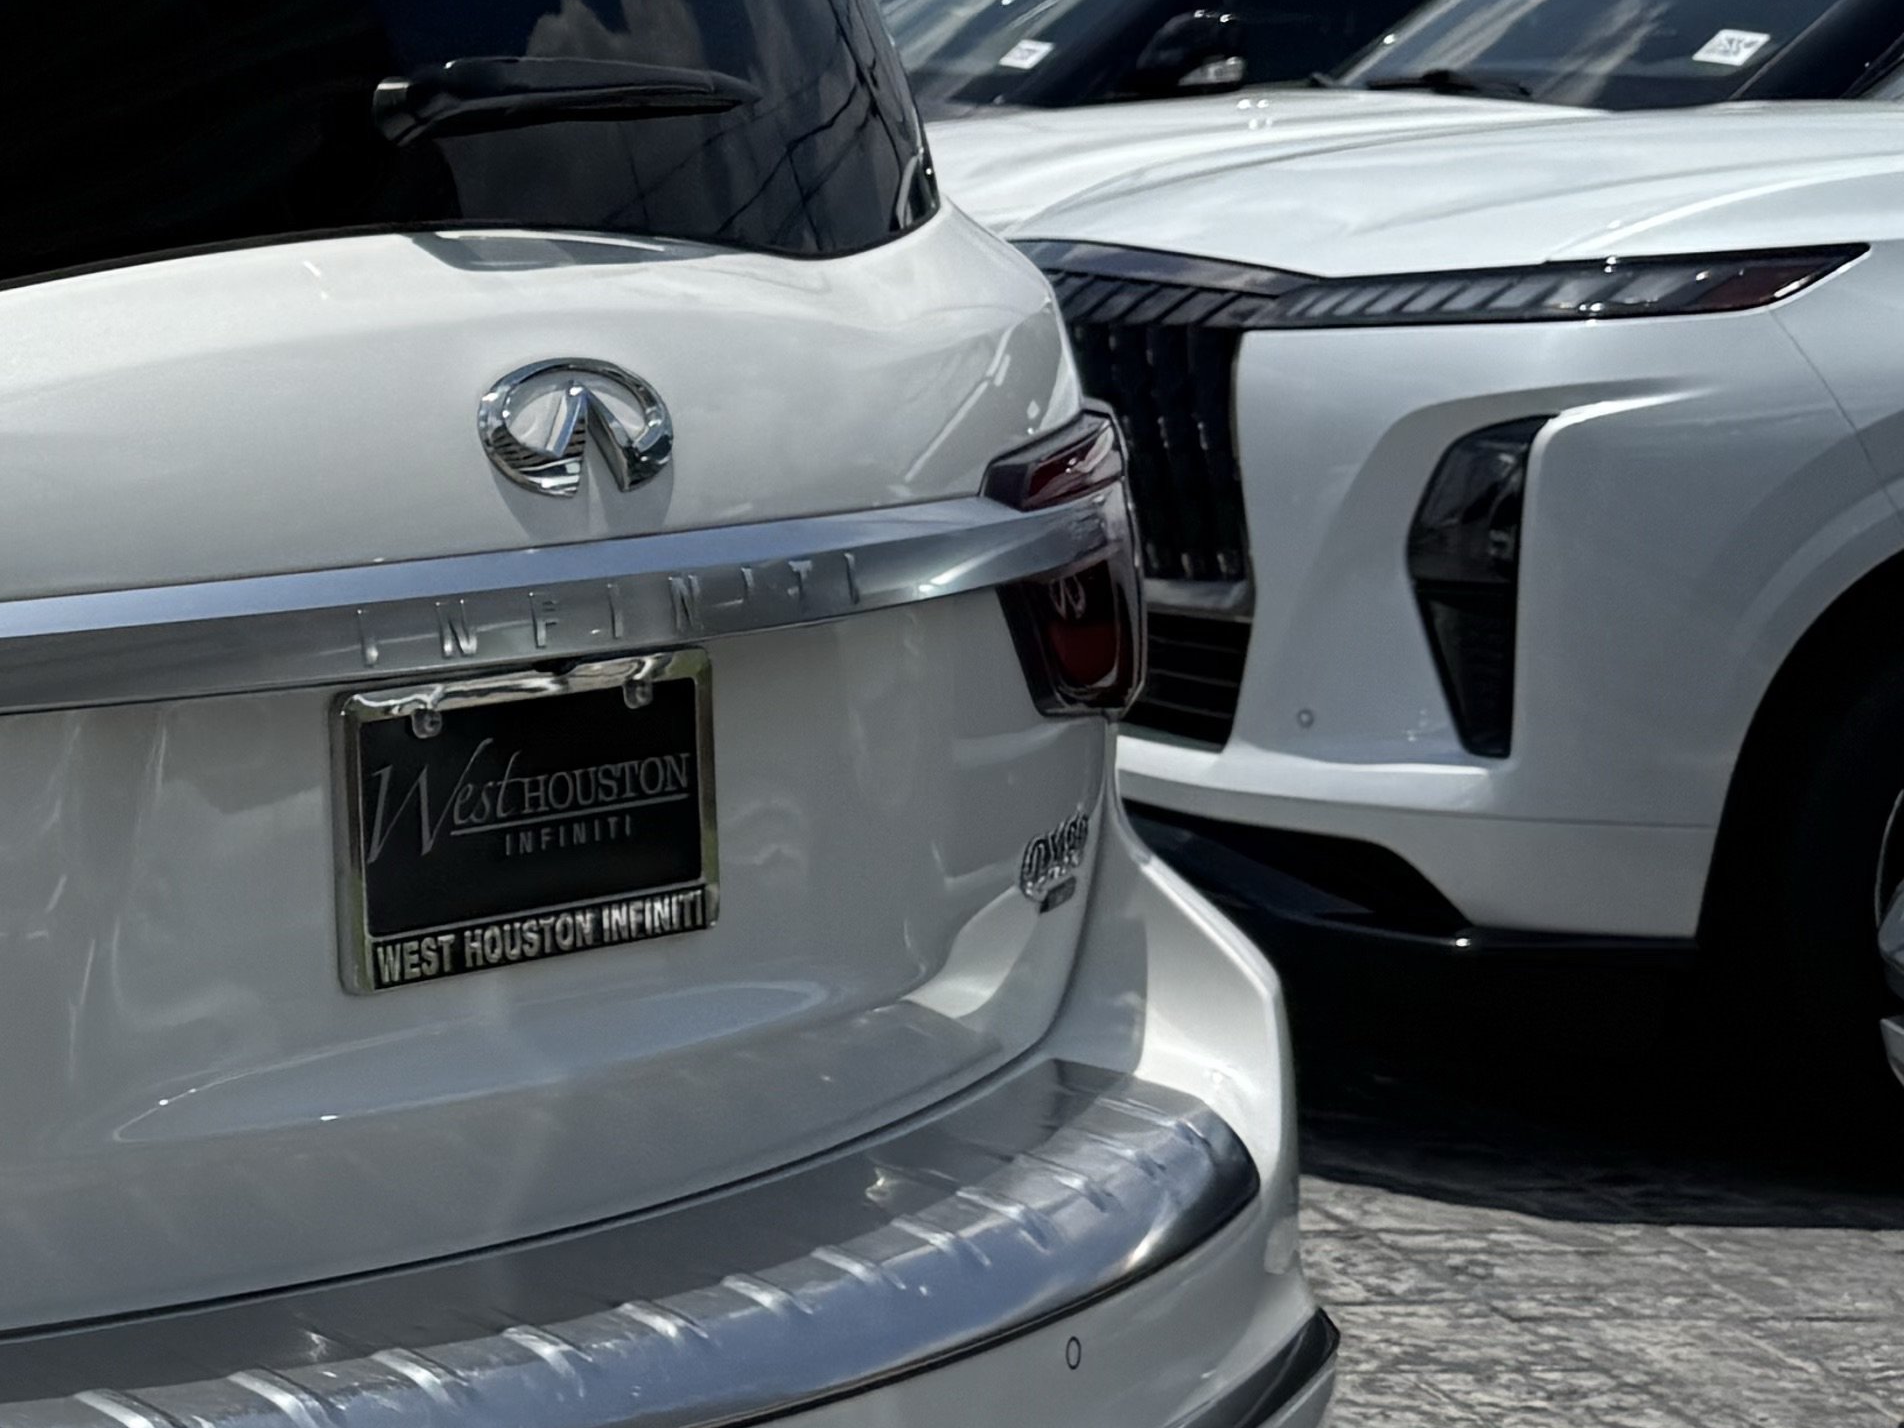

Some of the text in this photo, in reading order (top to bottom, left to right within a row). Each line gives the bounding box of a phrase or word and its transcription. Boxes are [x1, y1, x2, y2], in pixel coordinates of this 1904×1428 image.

[355, 551, 860, 667] INFINITI
[366, 737, 691, 864] West HOUSTON
[505, 814, 633, 856] INFINITI
[376, 888, 705, 984] WEST HOUSTON INFINITI
